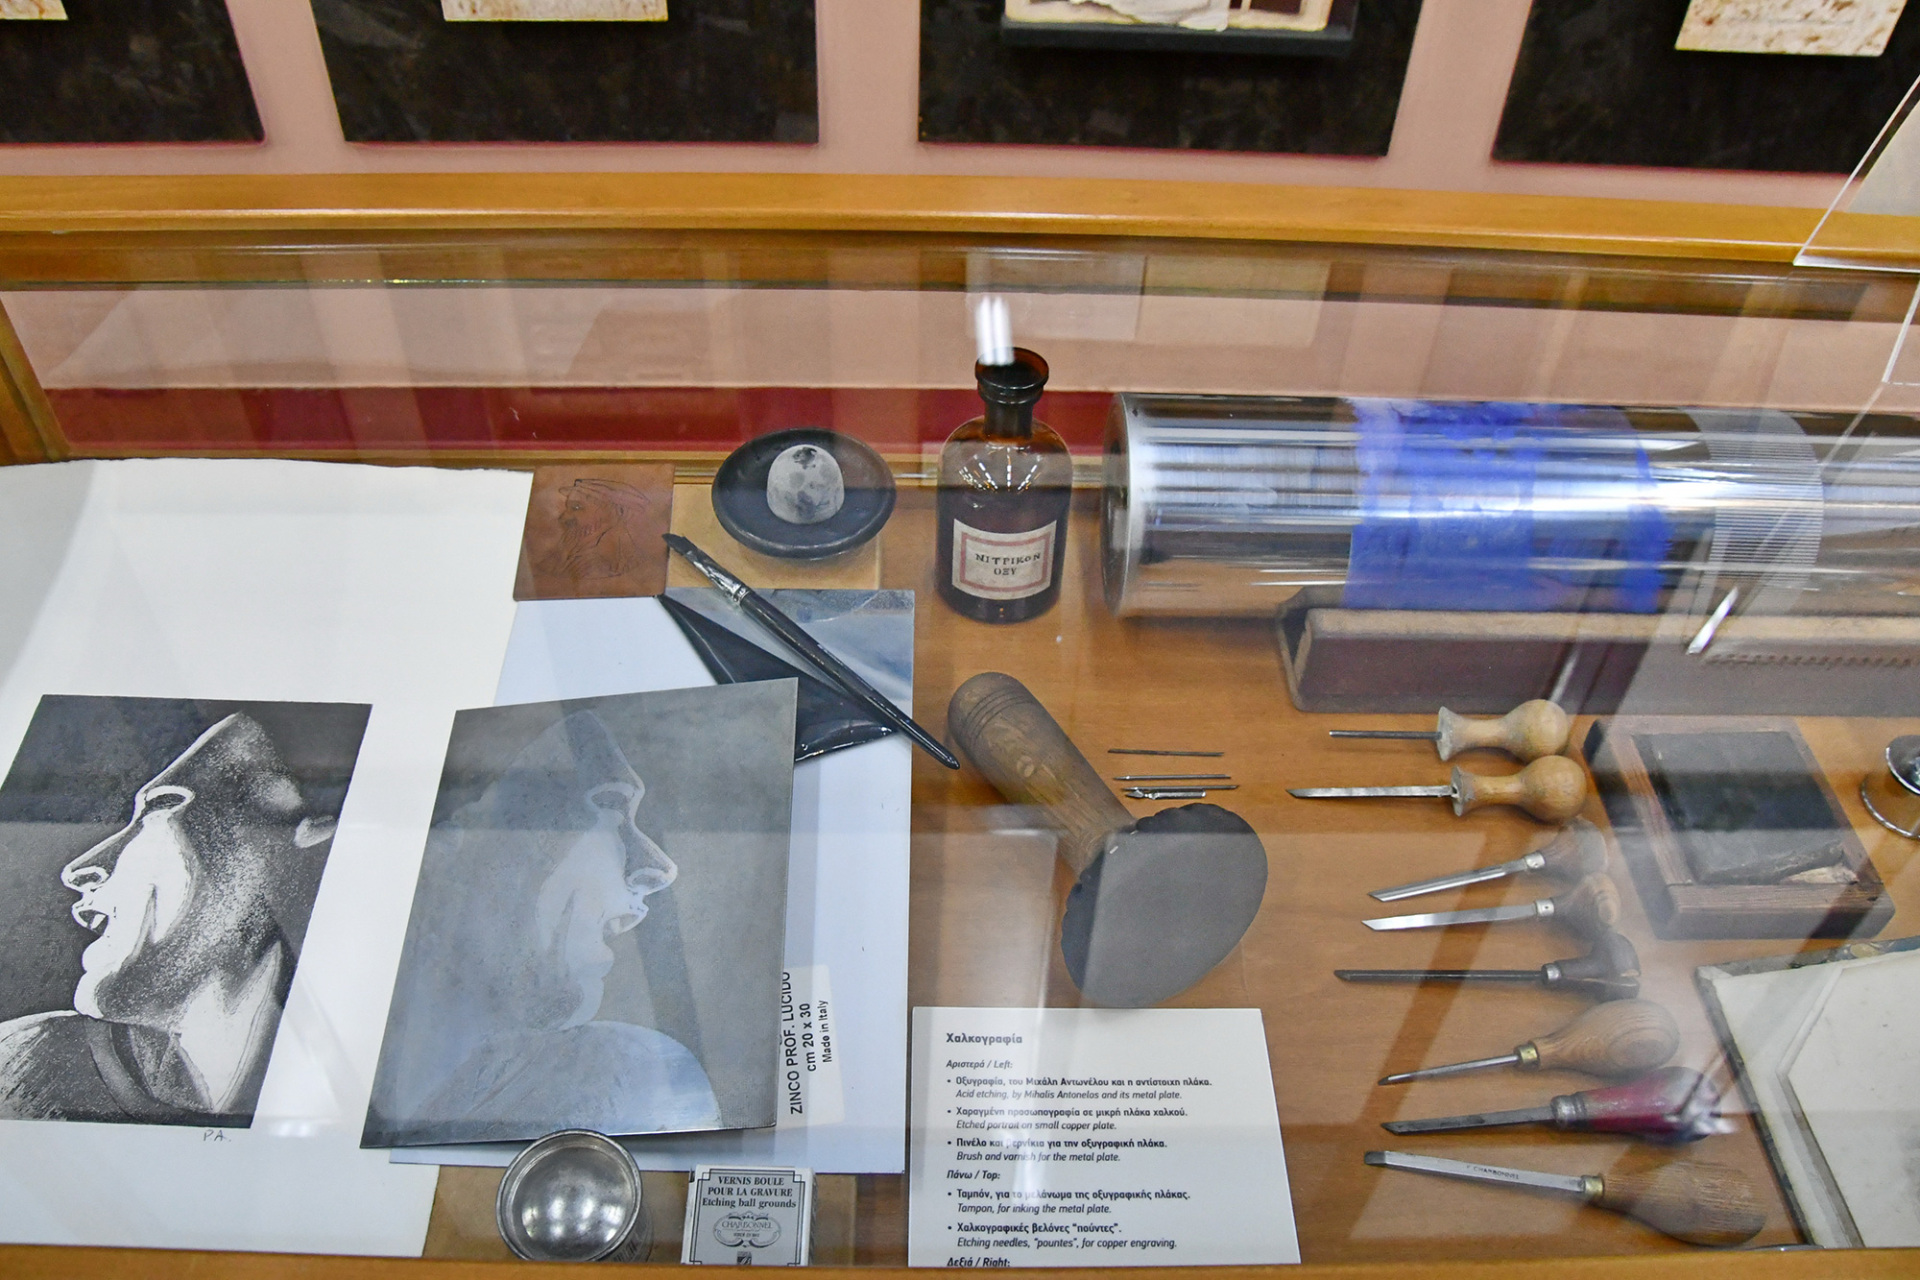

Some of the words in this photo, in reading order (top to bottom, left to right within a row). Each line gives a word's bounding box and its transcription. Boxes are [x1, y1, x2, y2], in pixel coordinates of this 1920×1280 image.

[975, 552, 1041, 565] ΝΙΤΡΙΚΟΝ
[994, 567, 1017, 576] ΟΞΥ
[799, 1003, 811, 1017] 30
[817, 1000, 828, 1021] Italy
[819, 1023, 830, 1032] in
[802, 1033, 814, 1047] 20
[946, 1033, 1022, 1045] Χαλκογραφία
[784, 1025, 798, 1066] PROF.
[821, 1035, 832, 1062] Made
[806, 1053, 816, 1071] cm
[946, 1060, 985, 1068] Αριστερά
[956, 1077, 1006, 1086] Οξυγραφία,
[1026, 1078, 1057, 1086] Μιχάλη
[1061, 1078, 1109, 1086] Αντωνέλου
[1136, 1078, 1180, 1086] αντίστοιχη
[1183, 1078, 1212, 1086] πλάκα.
[787, 1070, 802, 1115] ZINCO
[956, 1090, 974, 1098] Acid
[976, 1090, 1008, 1100] etching,
[1012, 1090, 1022, 1100] by
[1024, 1090, 1054, 1098] Mihalis
[1102, 1091, 1117, 1099] and
[1120, 1091, 1129, 1099] its
[1132, 1091, 1156, 1099] metal
[1158, 1091, 1182, 1101] plate.
[956, 1107, 1004, 1116] Χαραγμένη
[1008, 1107, 1079, 1117] προσωπογραφία
[1096, 1109, 1120, 1118] μικρή
[1154, 1107, 1187, 1116] χαλκού.
[956, 1120, 985, 1129] Etched
[987, 1121, 1019, 1130] portrait
[1035, 1121, 1059, 1129] small
[1062, 1122, 1090, 1131] copper
[1093, 1122, 1116, 1131] plate.
[956, 1138, 987, 1147] Πινέλο
[1081, 1139, 1134, 1149] οξυγραφική
[1137, 1139, 1167, 1147] πλάκα.
[957, 1152, 982, 1160] Brush
[985, 1152, 1001, 1160] and
[1004, 1152, 1035, 1161] varnish
[1038, 1152, 1050, 1162] for
[1053, 1152, 1066, 1161] the
[1069, 1153, 1094, 1161] metal
[1096, 1153, 1120, 1163] plate.
[718, 1176, 751, 1185] VERNIS
[754, 1177, 784, 1185] BOULE
[947, 1170, 972, 1179] Πάνω
[982, 1171, 1000, 1181] Top:
[708, 1187, 733, 1196] POUR
[736, 1188, 747, 1196] LA
[751, 1188, 792, 1197] GRAVURE
[957, 1189, 993, 1199] Ταμπόν,
[1075, 1192, 1089, 1200] της
[1093, 1190, 1152, 1200] οξυγραφικής
[1155, 1191, 1190, 1200] πλάκας.
[702, 1198, 735, 1208] Etching
[739, 1198, 756, 1207] ball
[758, 1199, 796, 1208] grounds
[958, 1203, 994, 1214] Tampon,
[997, 1204, 1010, 1214] for
[1013, 1204, 1039, 1215] inking
[1043, 1204, 1056, 1213] the
[1059, 1205, 1084, 1213] metal
[1087, 1205, 1111, 1215] plate.
[722, 1220, 772, 1229] CHARBONNEL
[957, 1222, 1028, 1234] Χαλκογραφικές
[1032, 1223, 1070, 1234] βελόνες
[958, 1237, 990, 1249] Etching
[993, 1238, 1030, 1248] needles,
[1082, 1238, 1094, 1249] for
[1097, 1240, 1128, 1249] copper
[1130, 1238, 1176, 1249] engraving.
[947, 1258, 973, 1267] Δεξιά
[983, 1258, 1010, 1267] Right:
